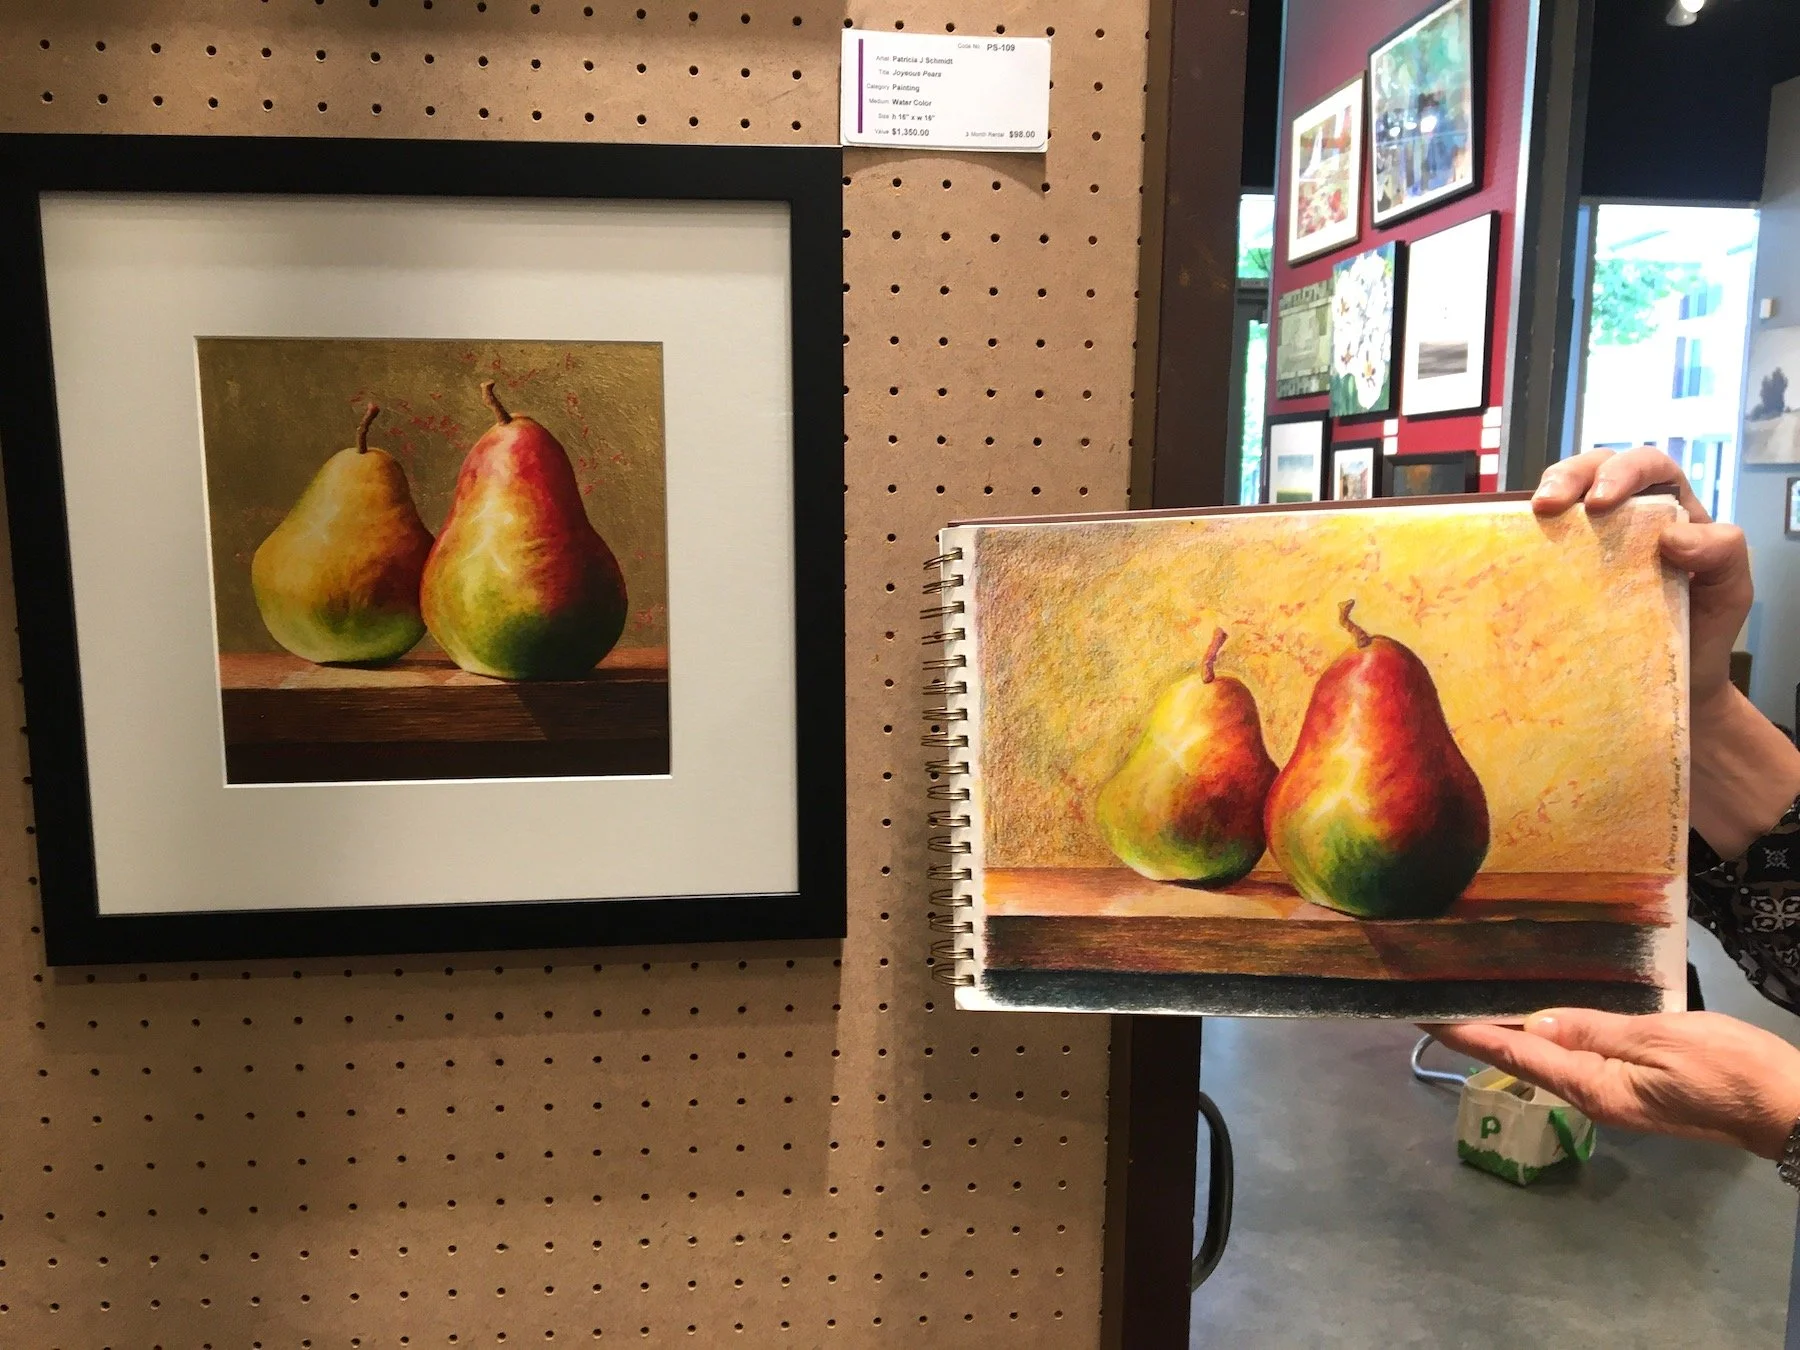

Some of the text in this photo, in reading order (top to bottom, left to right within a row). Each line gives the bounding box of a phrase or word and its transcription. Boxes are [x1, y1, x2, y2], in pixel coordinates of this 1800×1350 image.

[986, 43, 1016, 52] PS-109
[892, 55, 918, 63] Patricia
[925, 57, 953, 65] Schmidt
[892, 69, 921, 77] Joyeous
[866, 83, 920, 93] Category Painting
[891, 98, 912, 106] Water
[913, 99, 932, 107] Color
[891, 128, 930, 137] $1,350.00
[1009, 130, 1036, 139] $98.00
